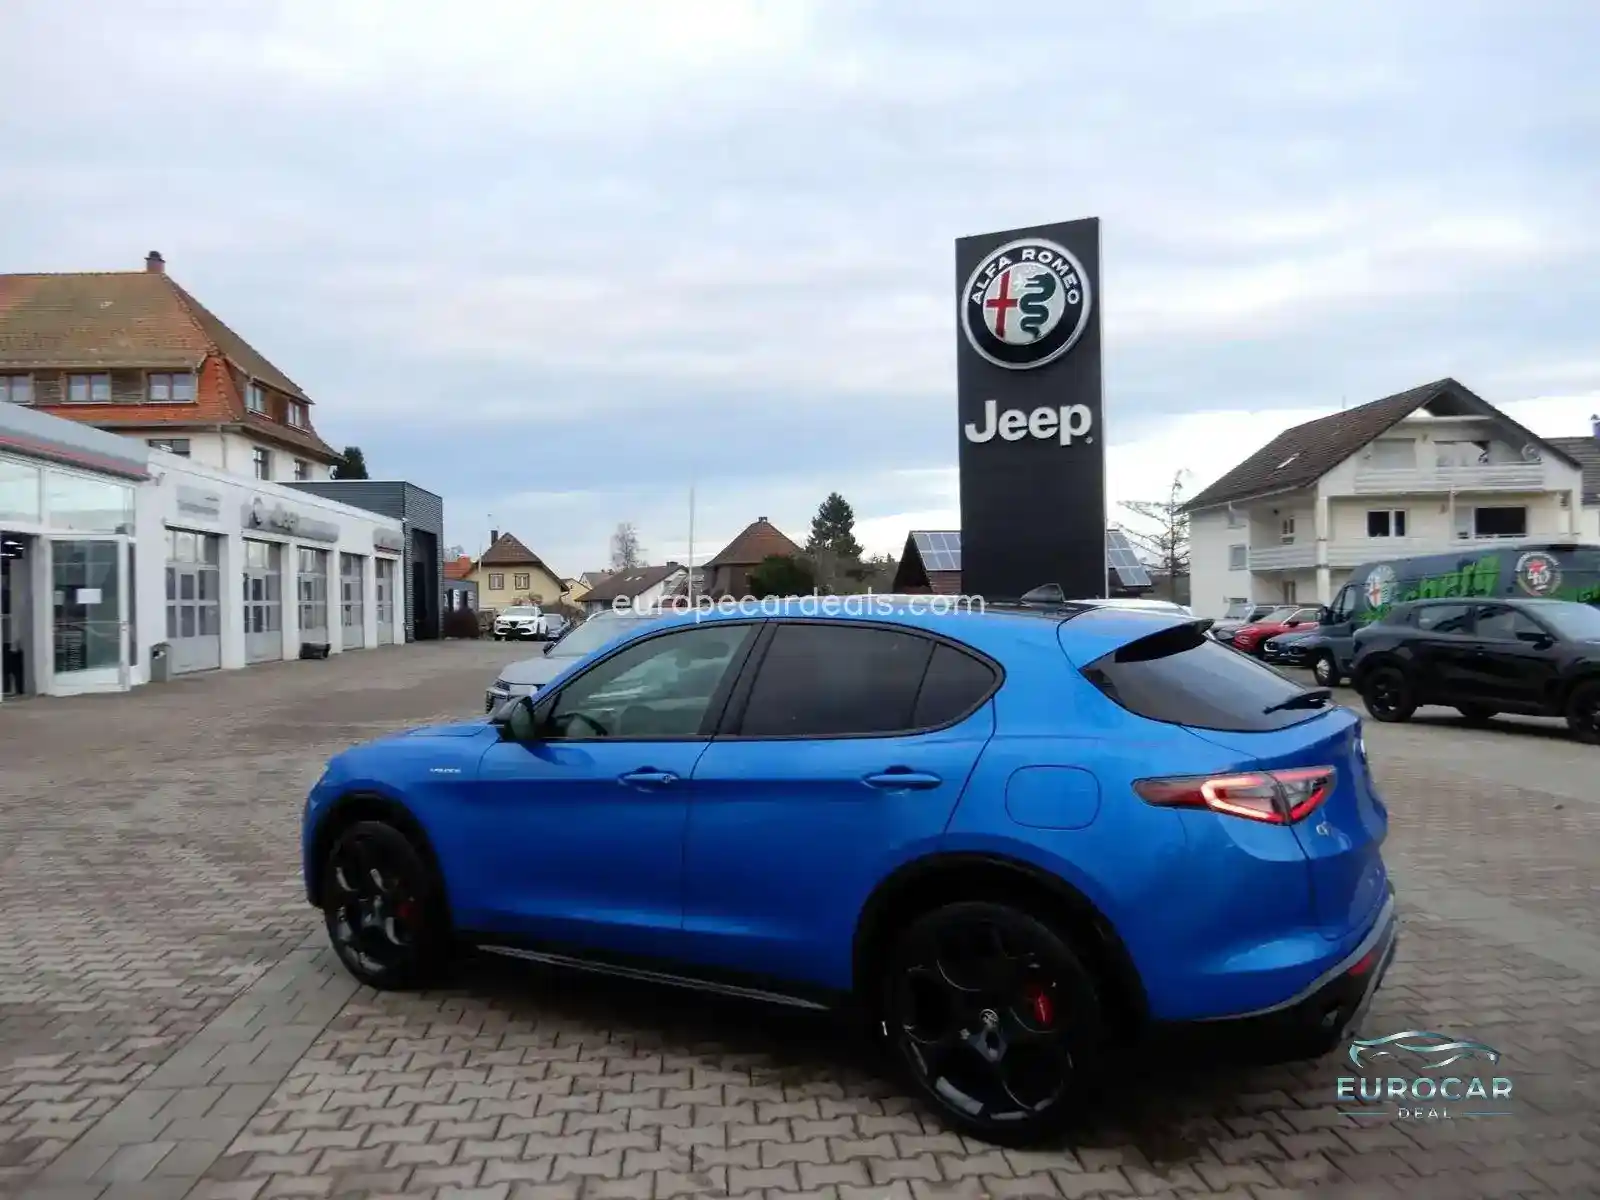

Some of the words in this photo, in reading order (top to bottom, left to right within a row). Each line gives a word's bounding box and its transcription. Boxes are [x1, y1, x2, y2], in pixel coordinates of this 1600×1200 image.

[970, 255, 1013, 305] ALFA
[1021, 248, 1080, 305] ROMEO
[964, 400, 1092, 446] Jeep
